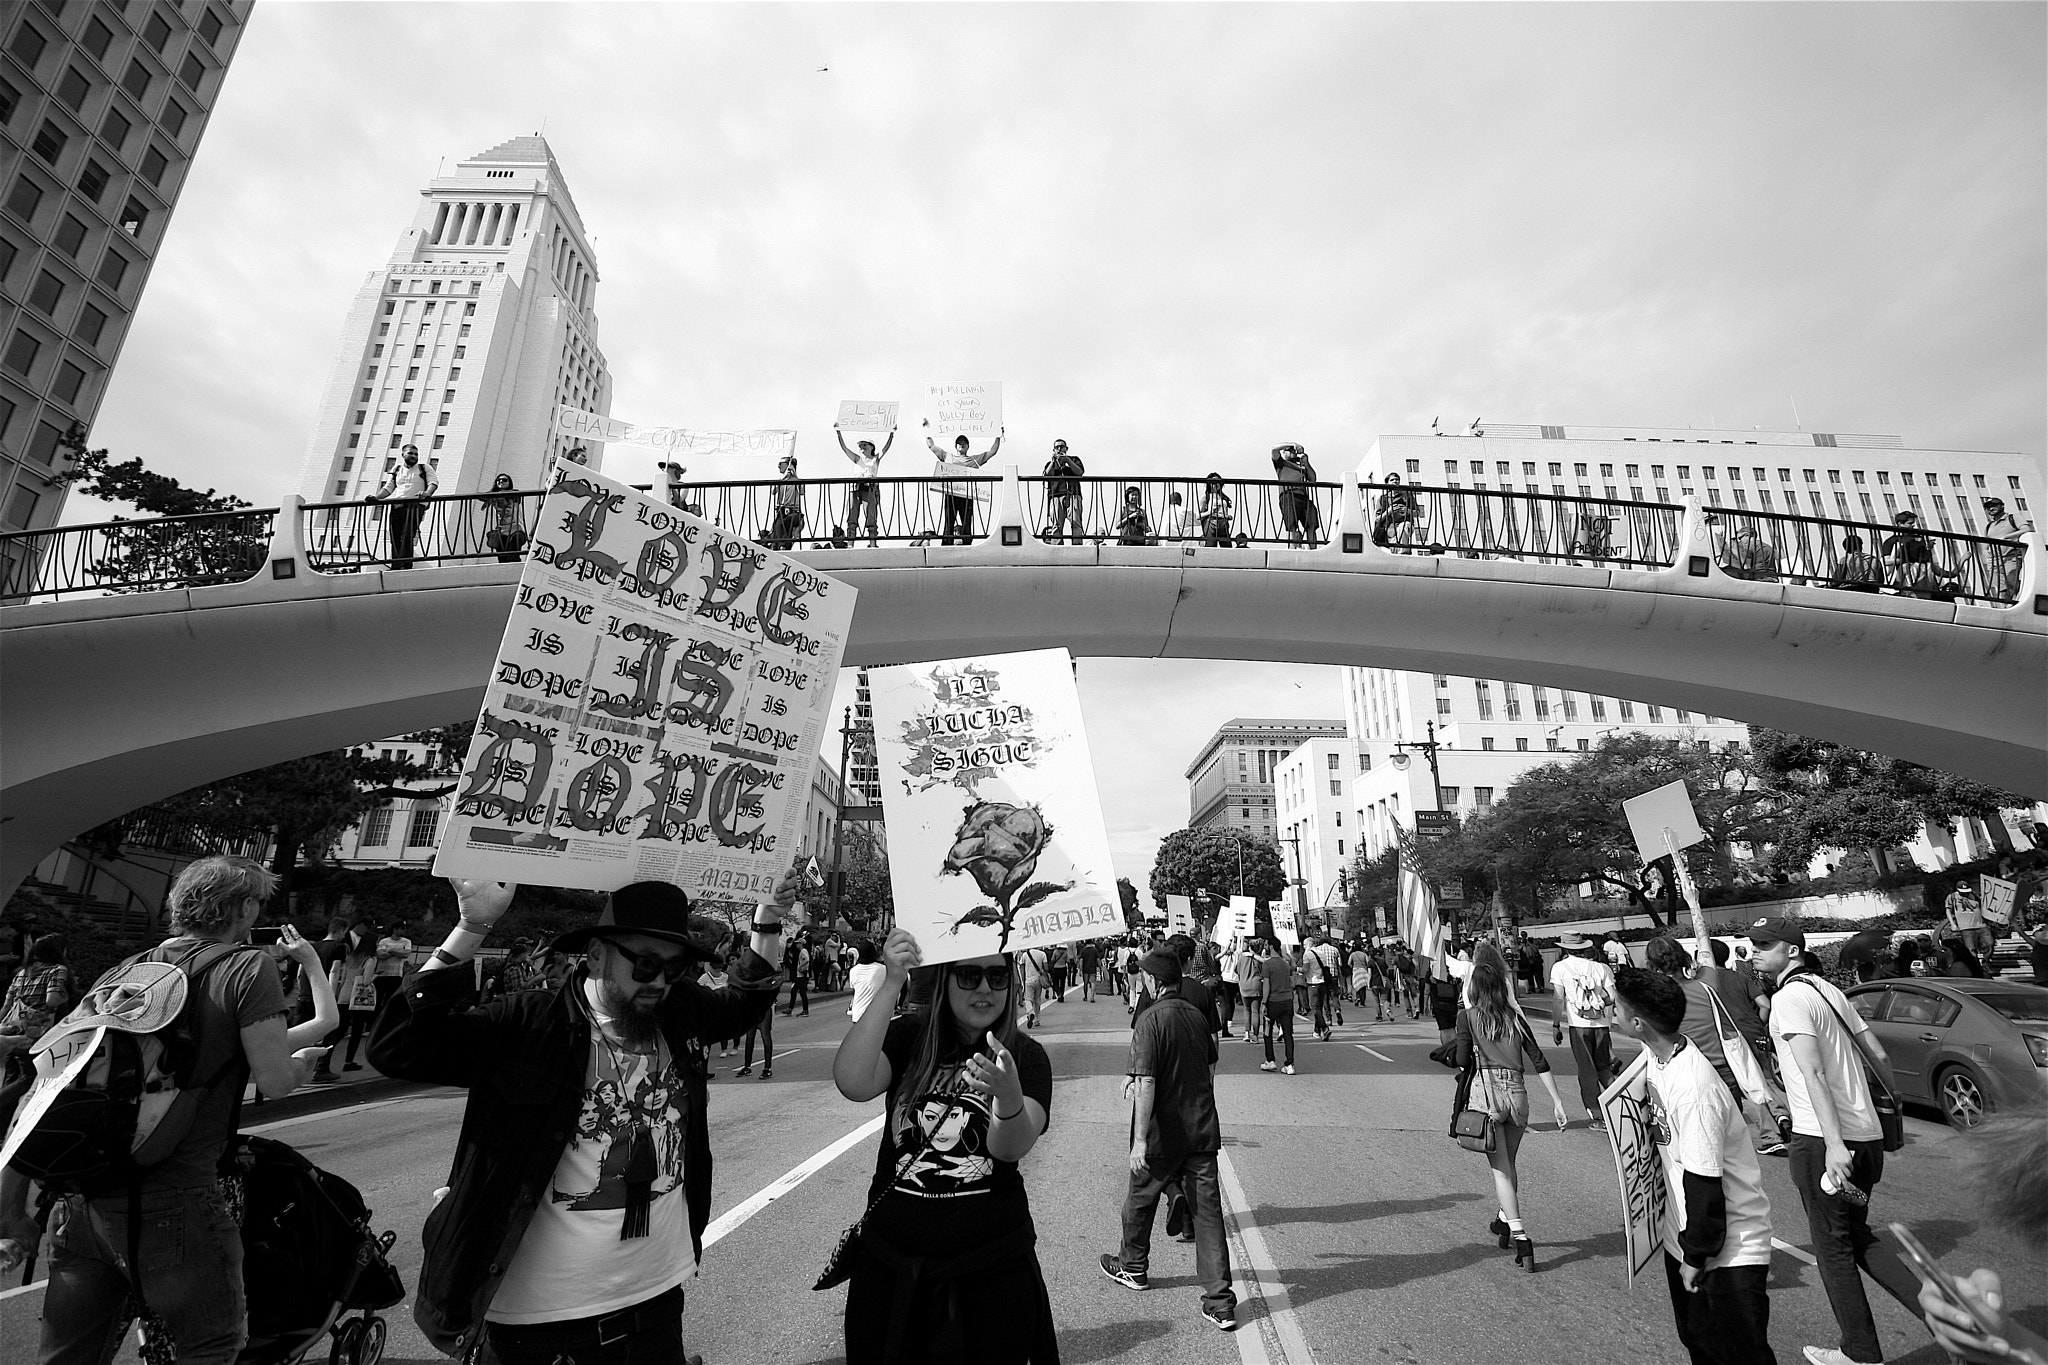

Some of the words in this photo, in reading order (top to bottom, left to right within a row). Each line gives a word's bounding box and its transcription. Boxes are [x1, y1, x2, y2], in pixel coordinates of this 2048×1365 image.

[560, 410, 634, 440] CHALE
[552, 467, 626, 513] LVE
[635, 502, 699, 544] LOVE
[1580, 515, 1620, 534] NOT
[713, 532, 767, 570] LOVE
[1573, 541, 1626, 556] PREDENT
[618, 570, 690, 611] DOPE
[781, 563, 829, 597] LOVE
[517, 584, 594, 624] LOVE
[524, 628, 565, 655] IS
[606, 616, 673, 651] LO
[497, 660, 583, 698] DOPE
[757, 660, 808, 690] LOVE
[951, 676, 987, 697] LA
[589, 687, 663, 720] DOE
[761, 694, 788, 716] IS
[477, 718, 560, 746] LVE
[926, 705, 1024, 735] LUCHA
[574, 732, 644, 764] LOVE
[743, 722, 799, 750] DOPE
[932, 742, 1031, 771] SIGUE
[736, 769, 785, 790] OVE
[670, 786, 693, 807] IS
[554, 805, 633, 836] DPE
[645, 818, 711, 845] OPE
[719, 831, 777, 854] OPE
[697, 868, 776, 894] MADLA
[1022, 903, 1116, 939] MADLA
[1621, 1143, 1646, 1229] PENCE
